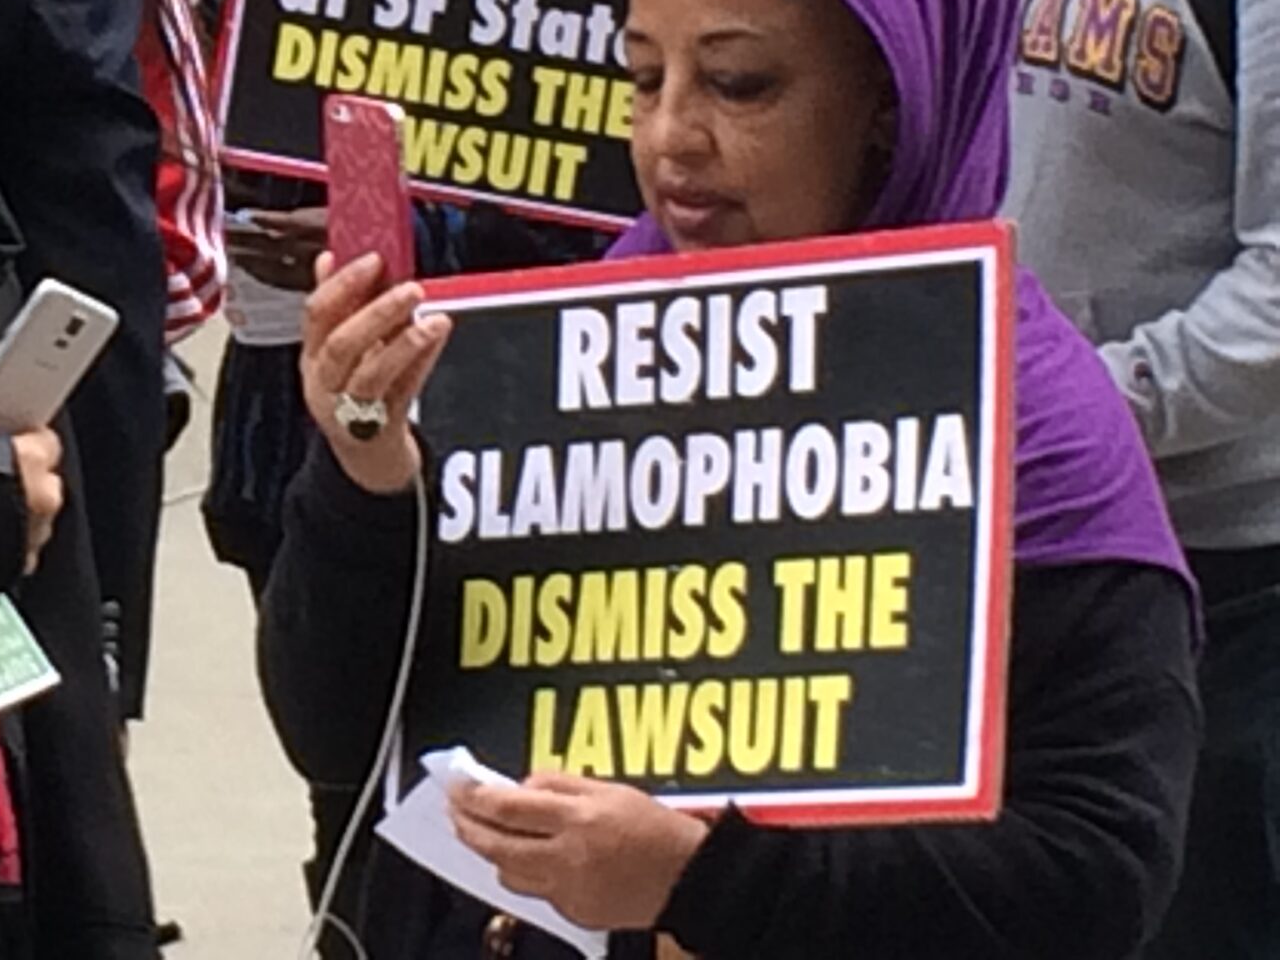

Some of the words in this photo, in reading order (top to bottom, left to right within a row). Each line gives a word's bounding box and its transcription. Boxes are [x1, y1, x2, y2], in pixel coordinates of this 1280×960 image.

[272, 22, 513, 117] DISMISS
[532, 66, 635, 139] THE
[403, 115, 588, 200] WSUIT
[556, 285, 828, 411] RESIST
[438, 413, 974, 542] SLAMOPHOBIA
[459, 563, 747, 668] DISMISS
[773, 552, 911, 654] THE
[530, 675, 853, 779] LAWSUIT
